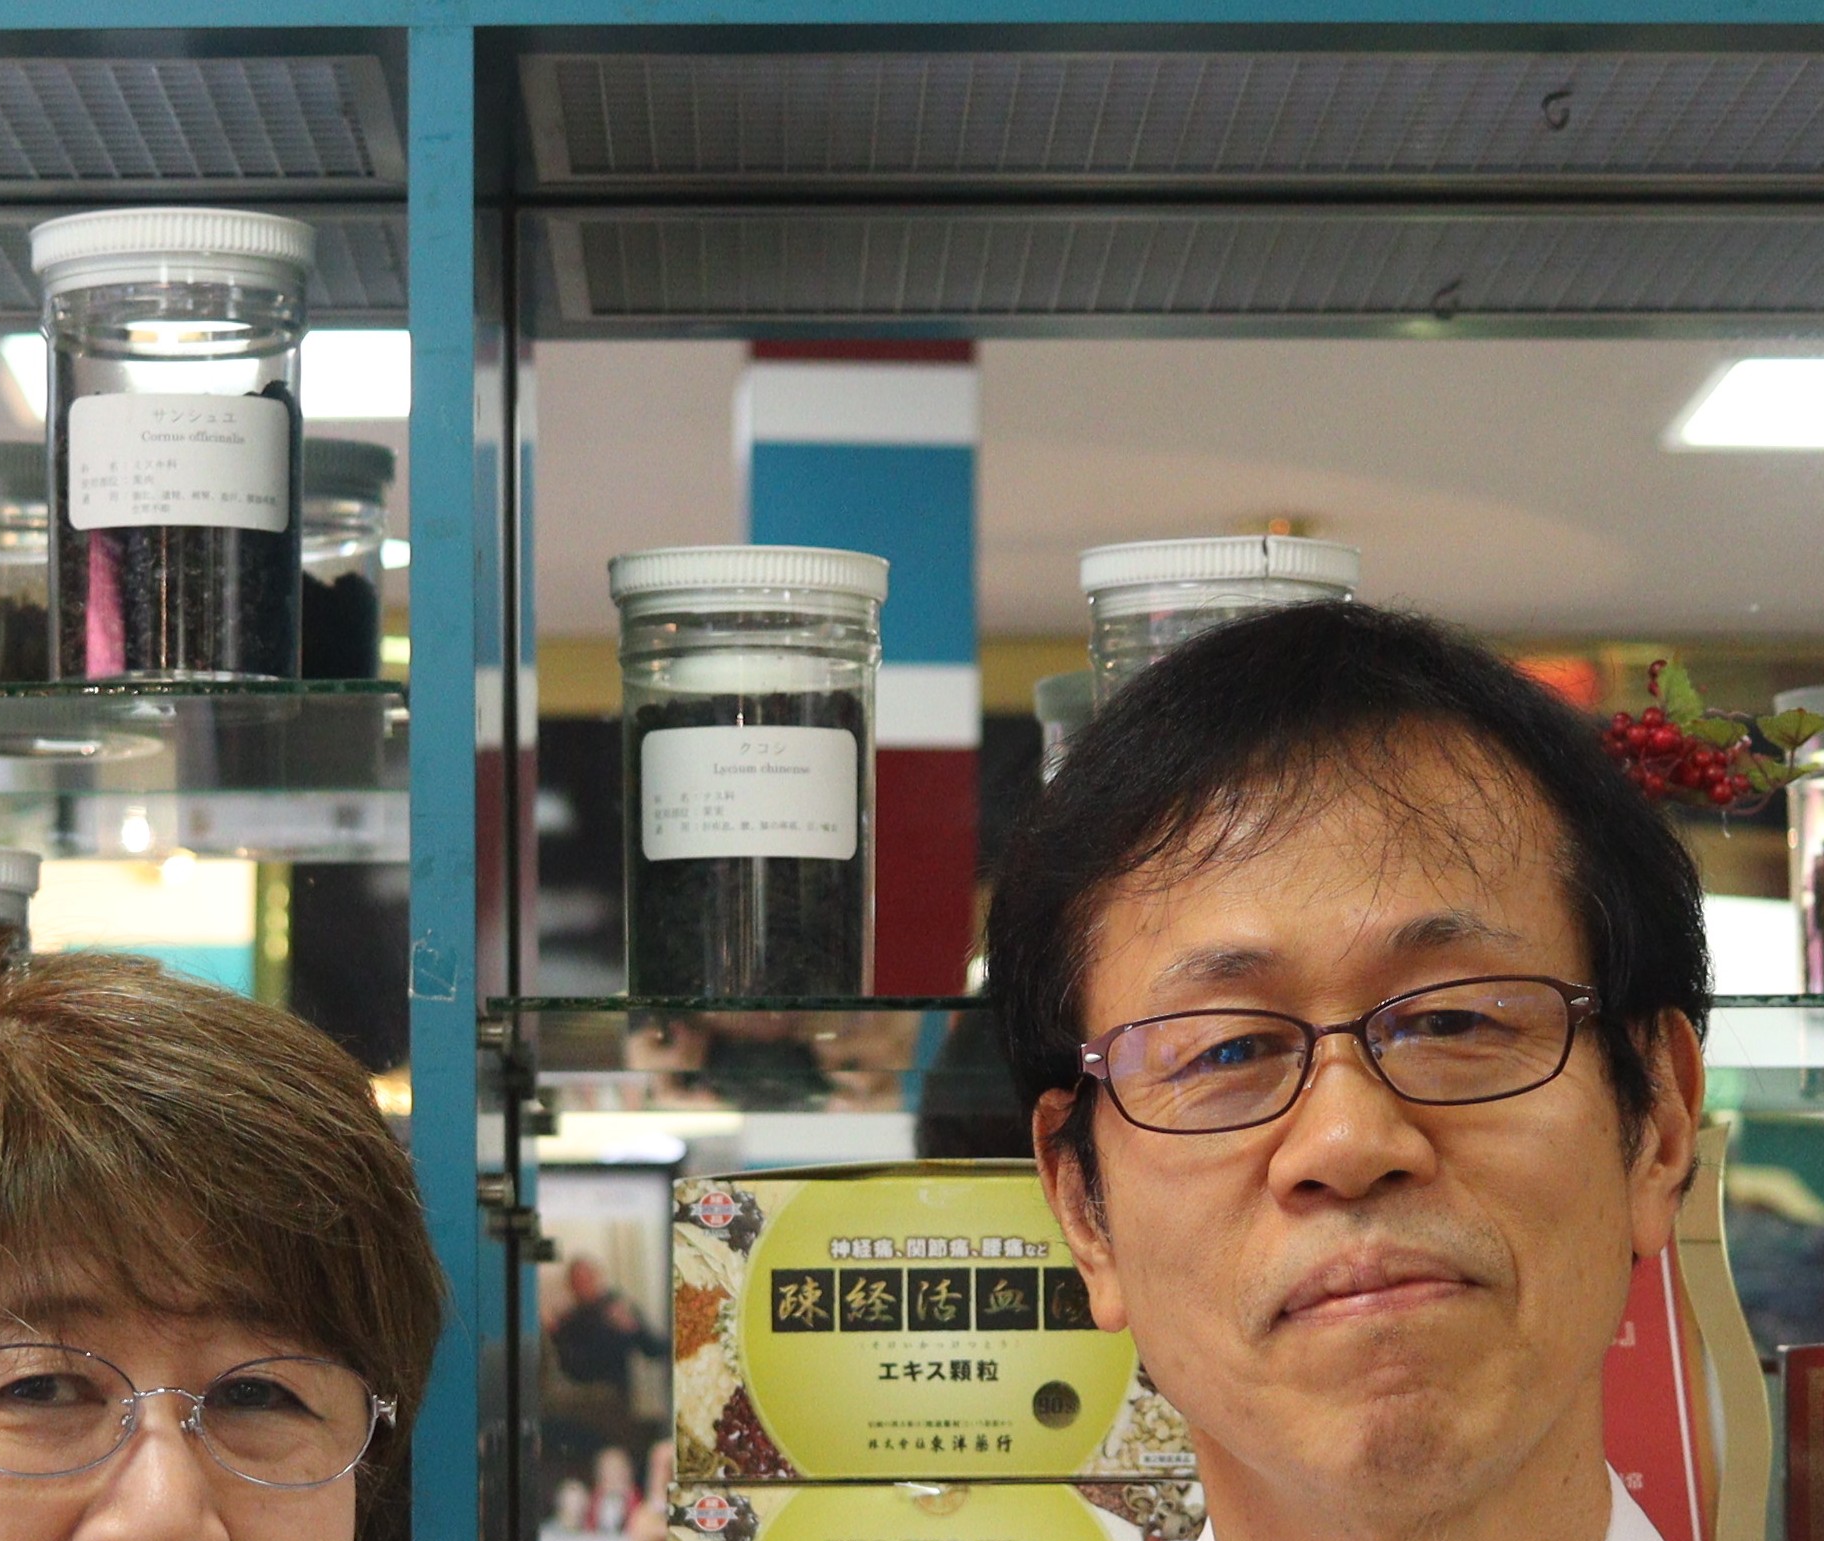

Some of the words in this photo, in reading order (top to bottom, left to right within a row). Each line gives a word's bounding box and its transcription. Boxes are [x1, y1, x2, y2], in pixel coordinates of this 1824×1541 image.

[153, 409, 237, 423] サンシュユ
[141, 431, 186, 442] Cornus
[878, 1359, 999, 1383] エキス顆粒
